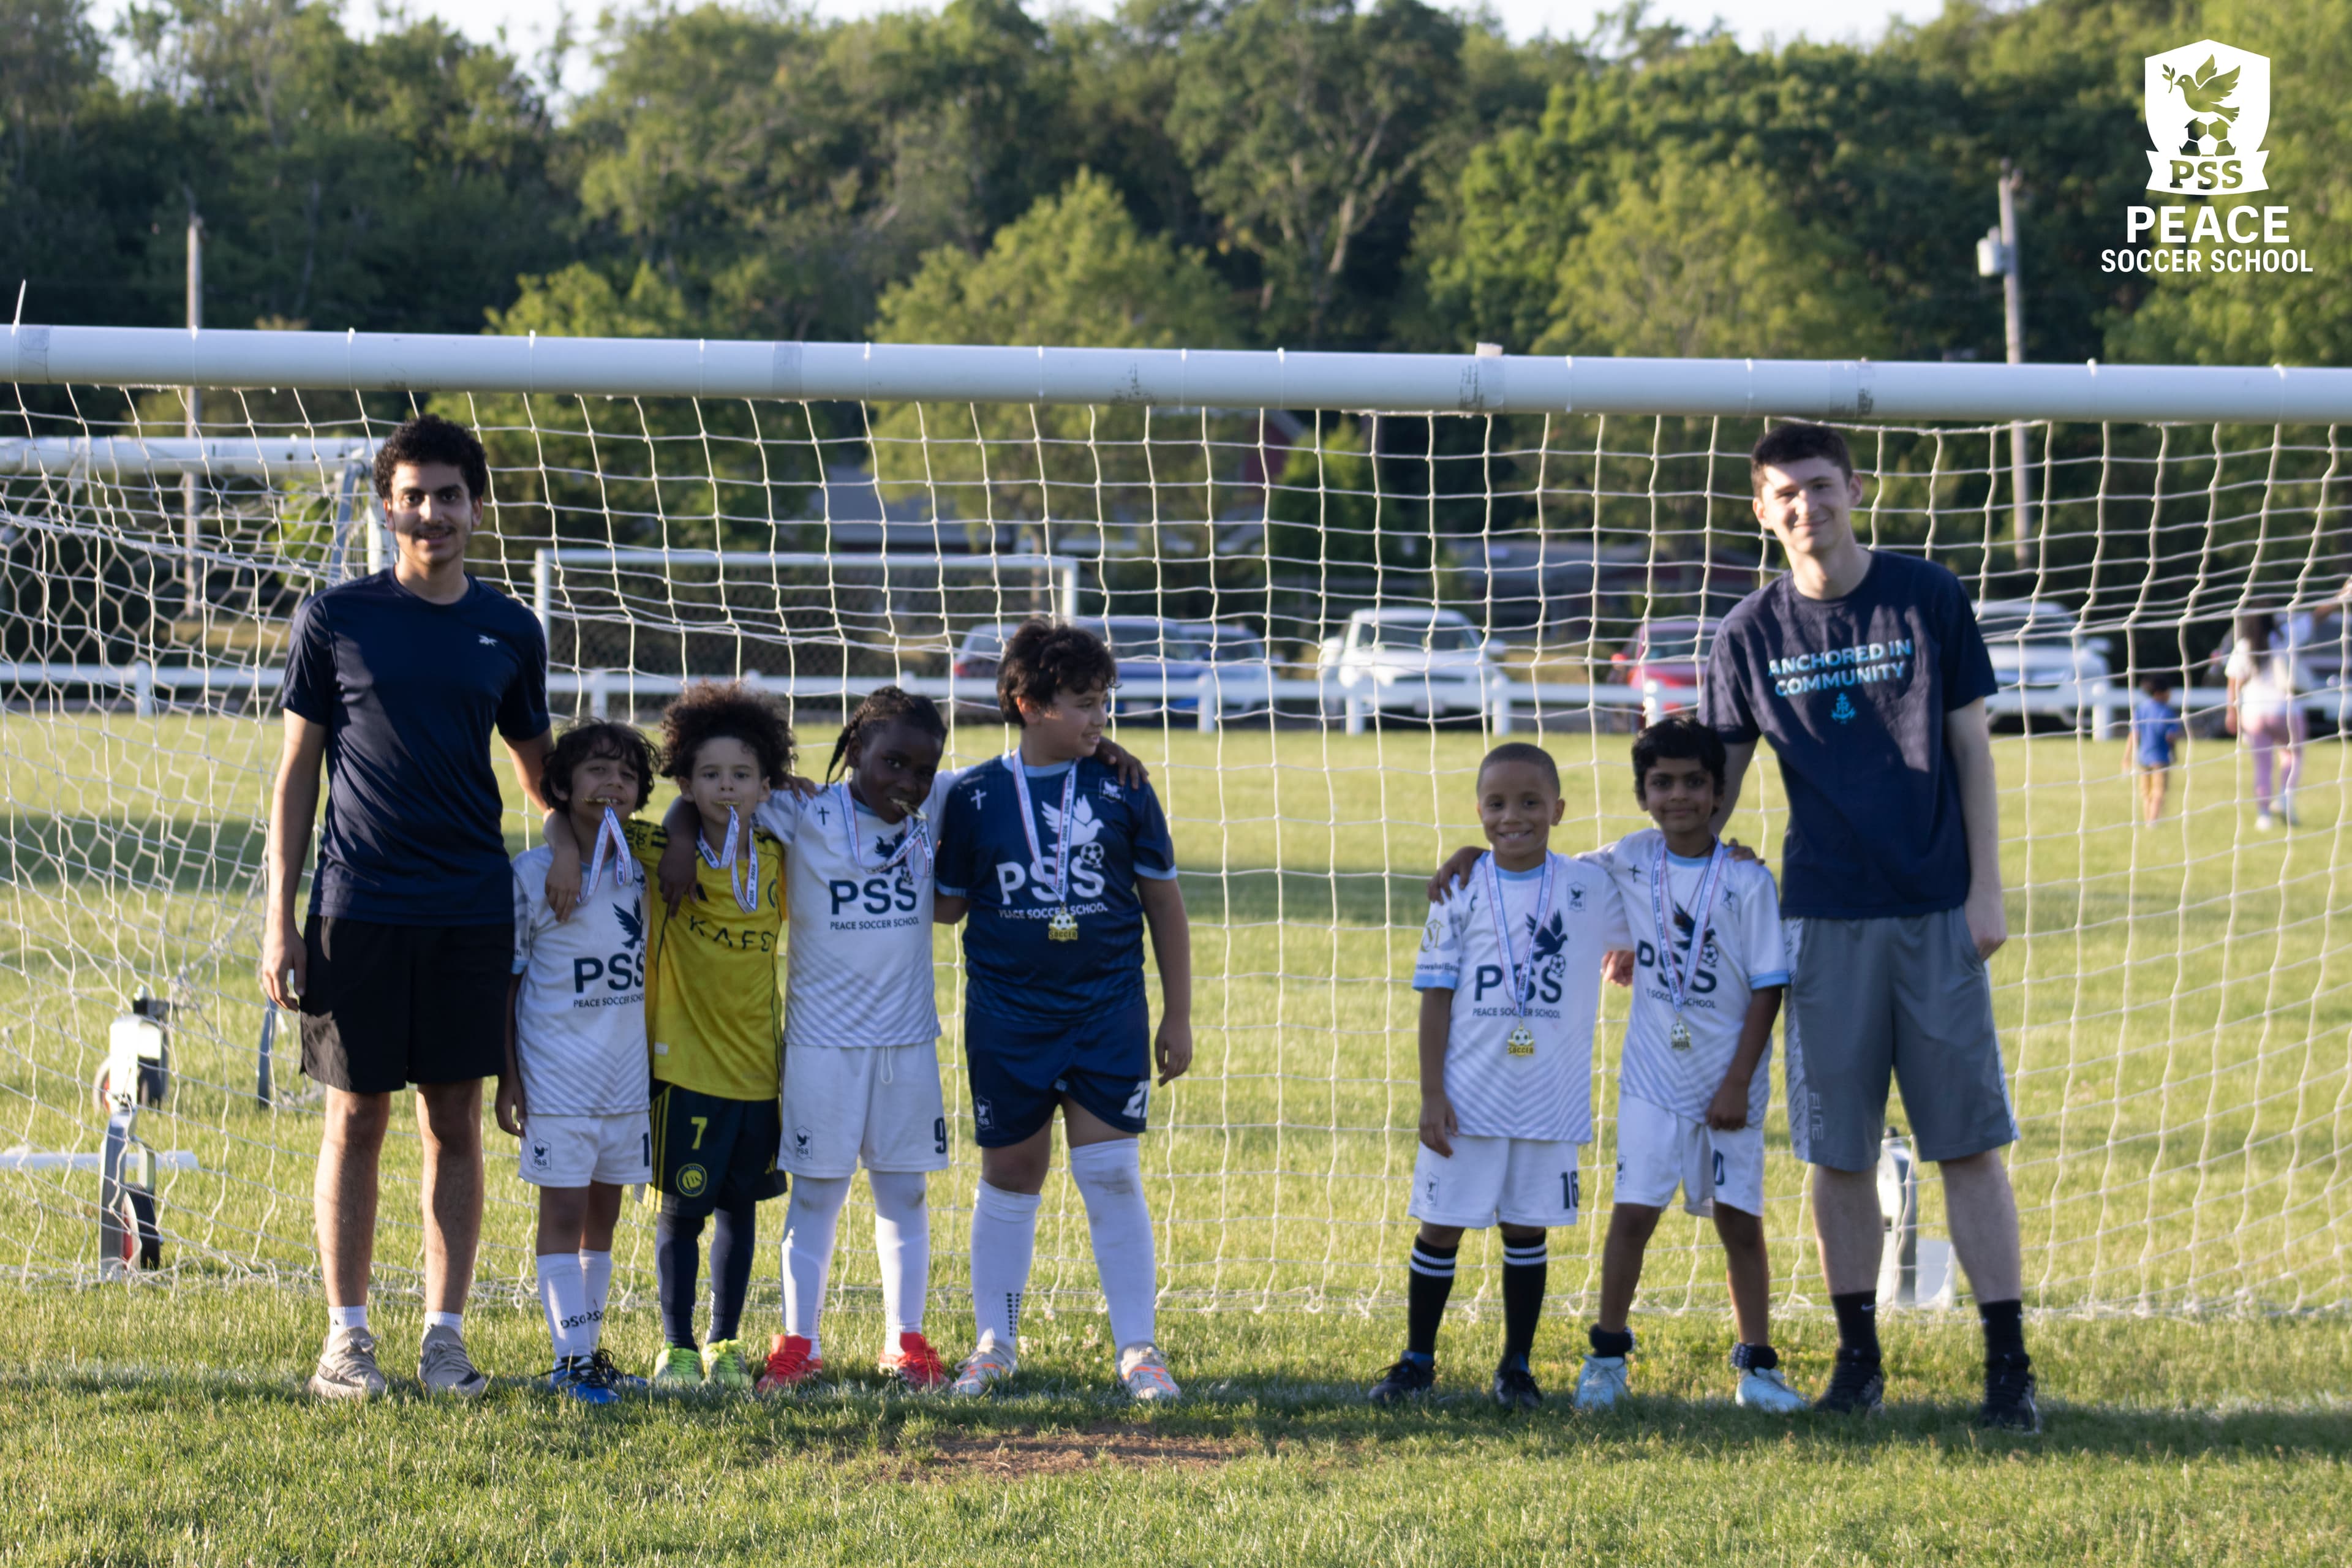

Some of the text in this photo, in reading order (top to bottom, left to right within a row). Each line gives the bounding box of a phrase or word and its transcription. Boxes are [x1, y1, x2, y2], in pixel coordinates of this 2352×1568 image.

[1768, 638, 1912, 676] ANCHORED IN
[1775, 662, 1905, 696] COMMUNITY
[829, 876, 918, 915] PSS
[830, 921, 856, 930] PEACE
[859, 919, 892, 930] SOCCER
[574, 952, 644, 993] PSS
[574, 999, 600, 1008] PEACE
[602, 996, 629, 1006] SOCCER
[1472, 1008, 1561, 1019] PEACE SOCER SCHOOL
[690, 1117, 708, 1150] 7
[933, 1117, 947, 1154] 9
